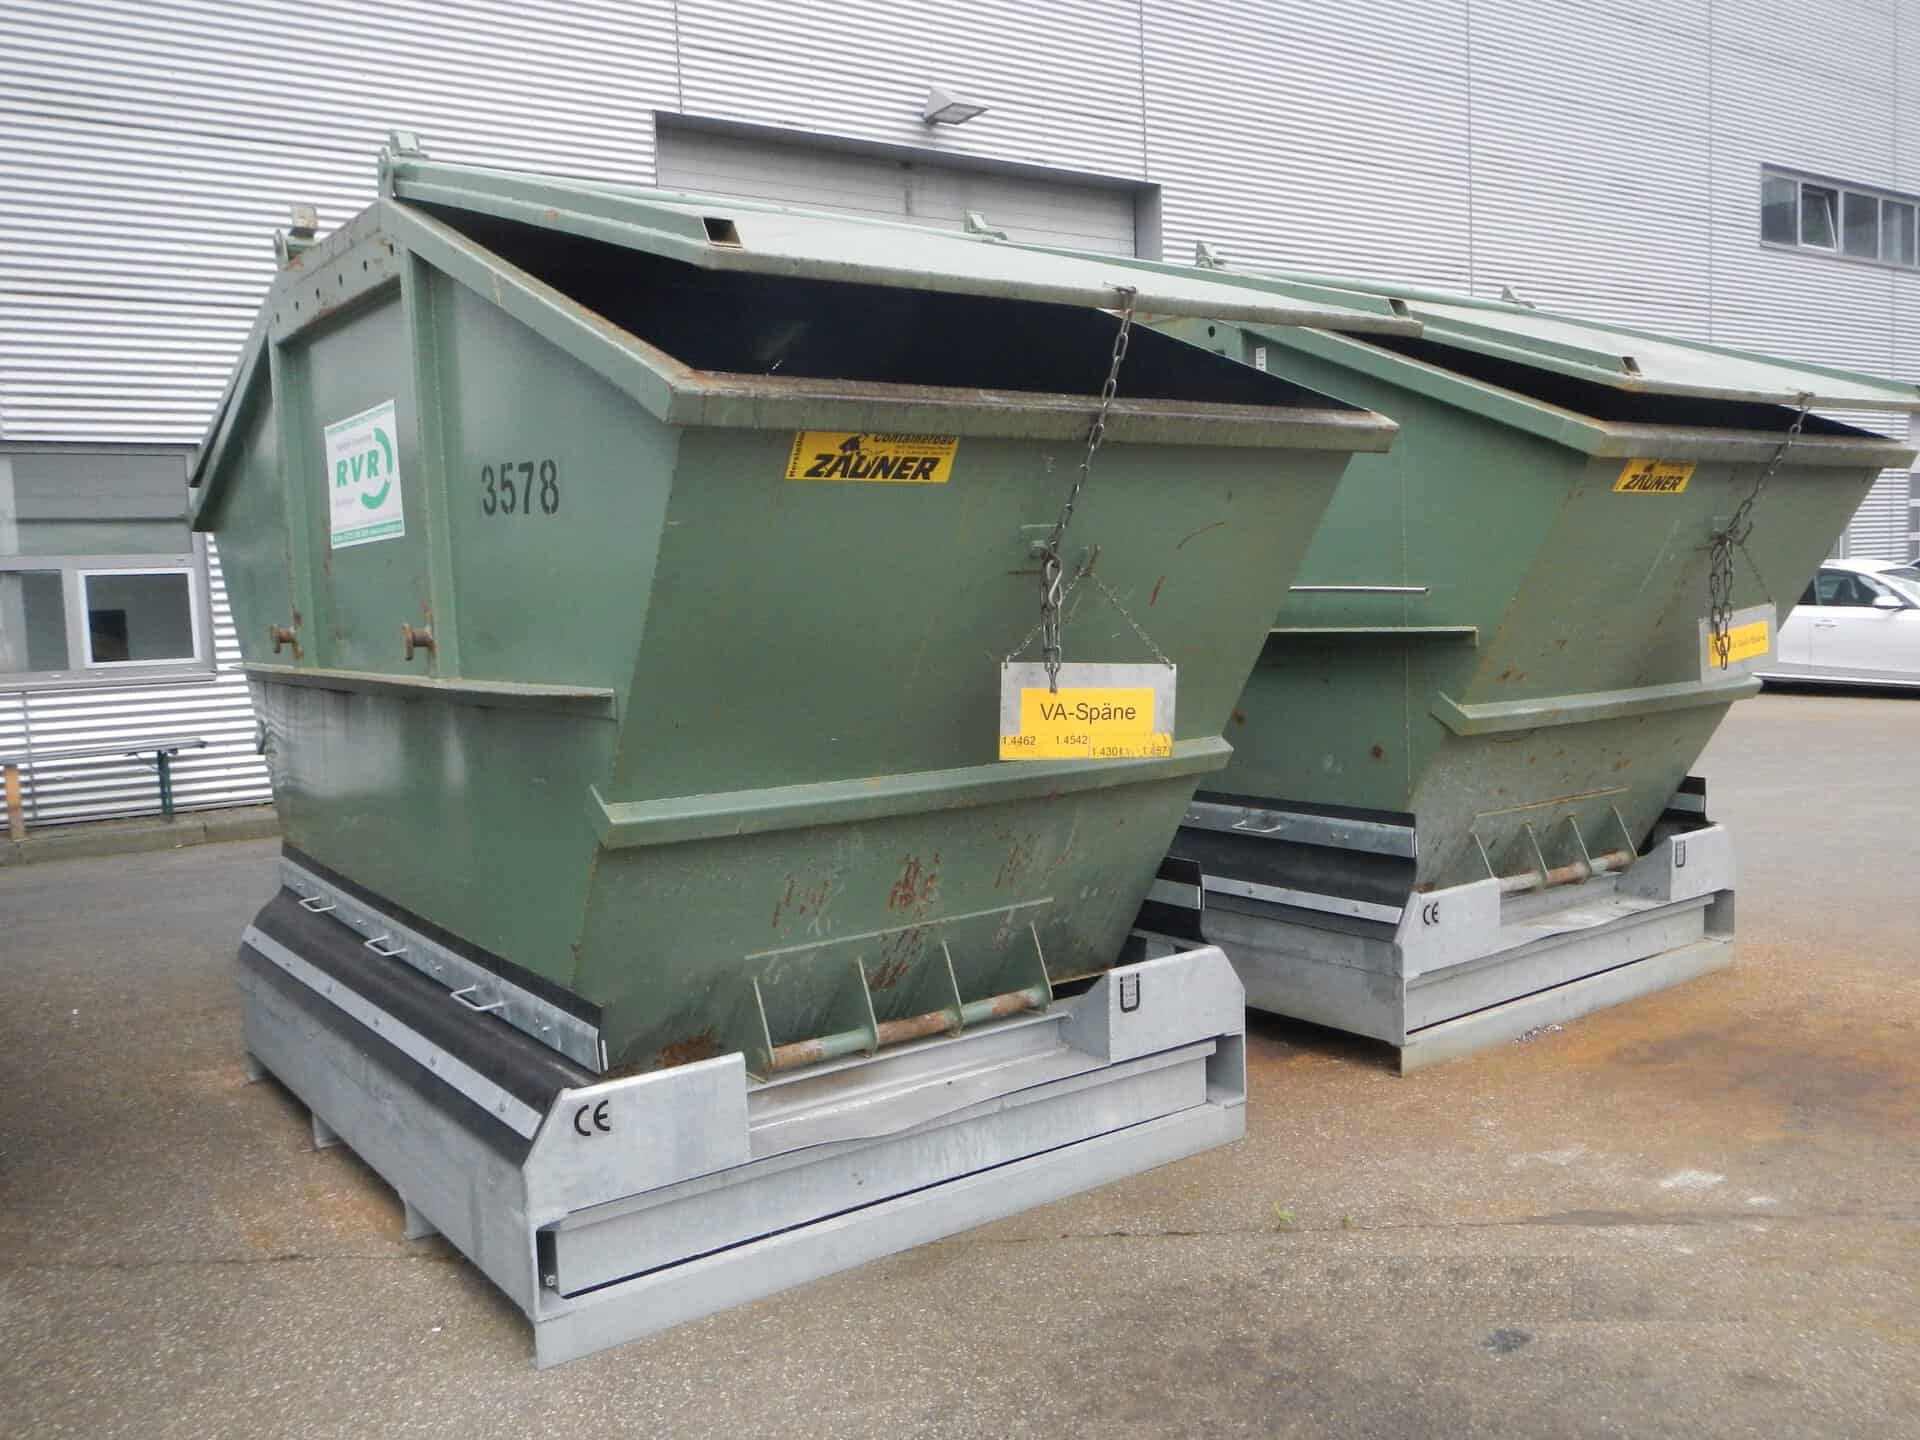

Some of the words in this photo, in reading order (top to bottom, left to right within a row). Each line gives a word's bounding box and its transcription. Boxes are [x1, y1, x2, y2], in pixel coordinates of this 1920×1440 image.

[336, 450, 379, 488] RVR
[804, 453, 941, 480] ZAUNER
[481, 459, 560, 516] 3578
[1040, 702, 1136, 725] VA-Späne
[574, 1099, 611, 1137] CE
